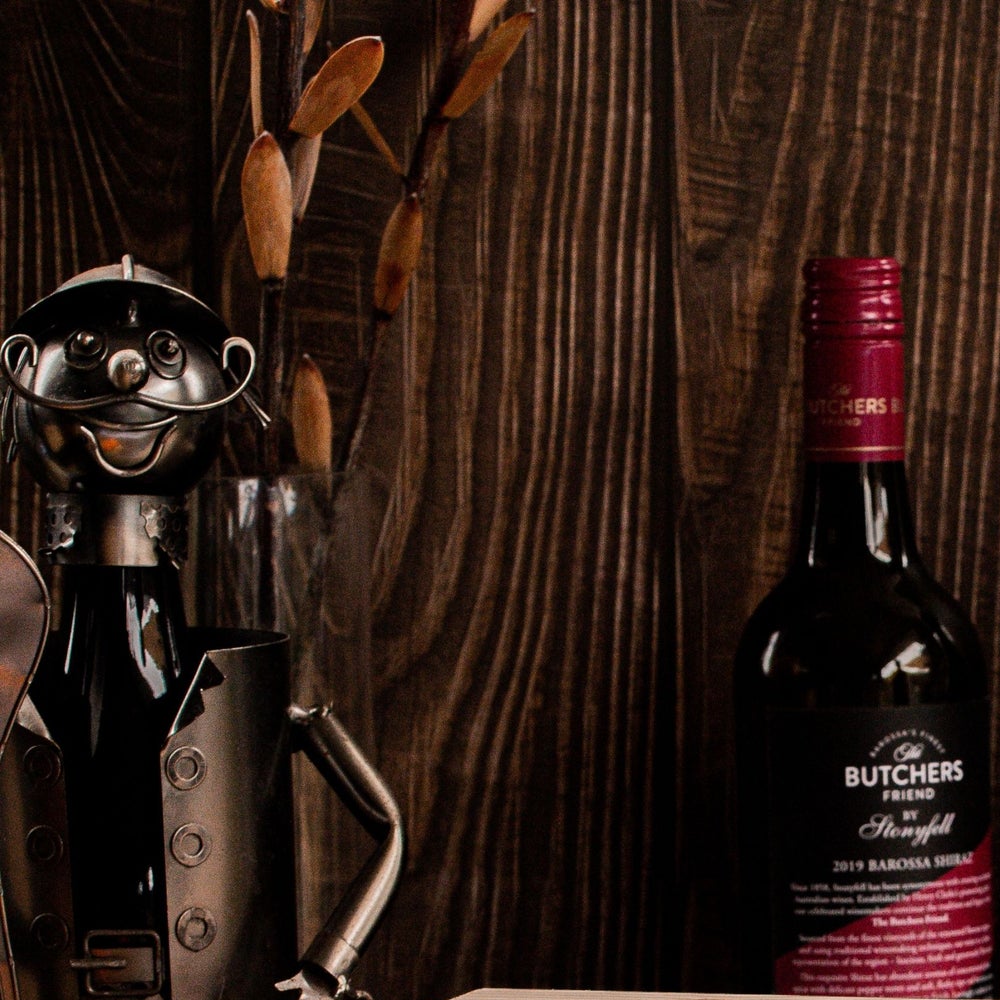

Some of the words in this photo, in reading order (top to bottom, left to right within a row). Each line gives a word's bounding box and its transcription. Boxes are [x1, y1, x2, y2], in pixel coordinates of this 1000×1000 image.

[845, 760, 964, 788] BUTCHERS
[882, 787, 936, 802] FRIEND
[902, 809, 919, 821] BY
[858, 812, 956, 848] Stonyfell
[832, 860, 865, 873] 2019
[868, 857, 932, 873] BAROSSA
[934, 851, 974, 869] SHIRAZ
